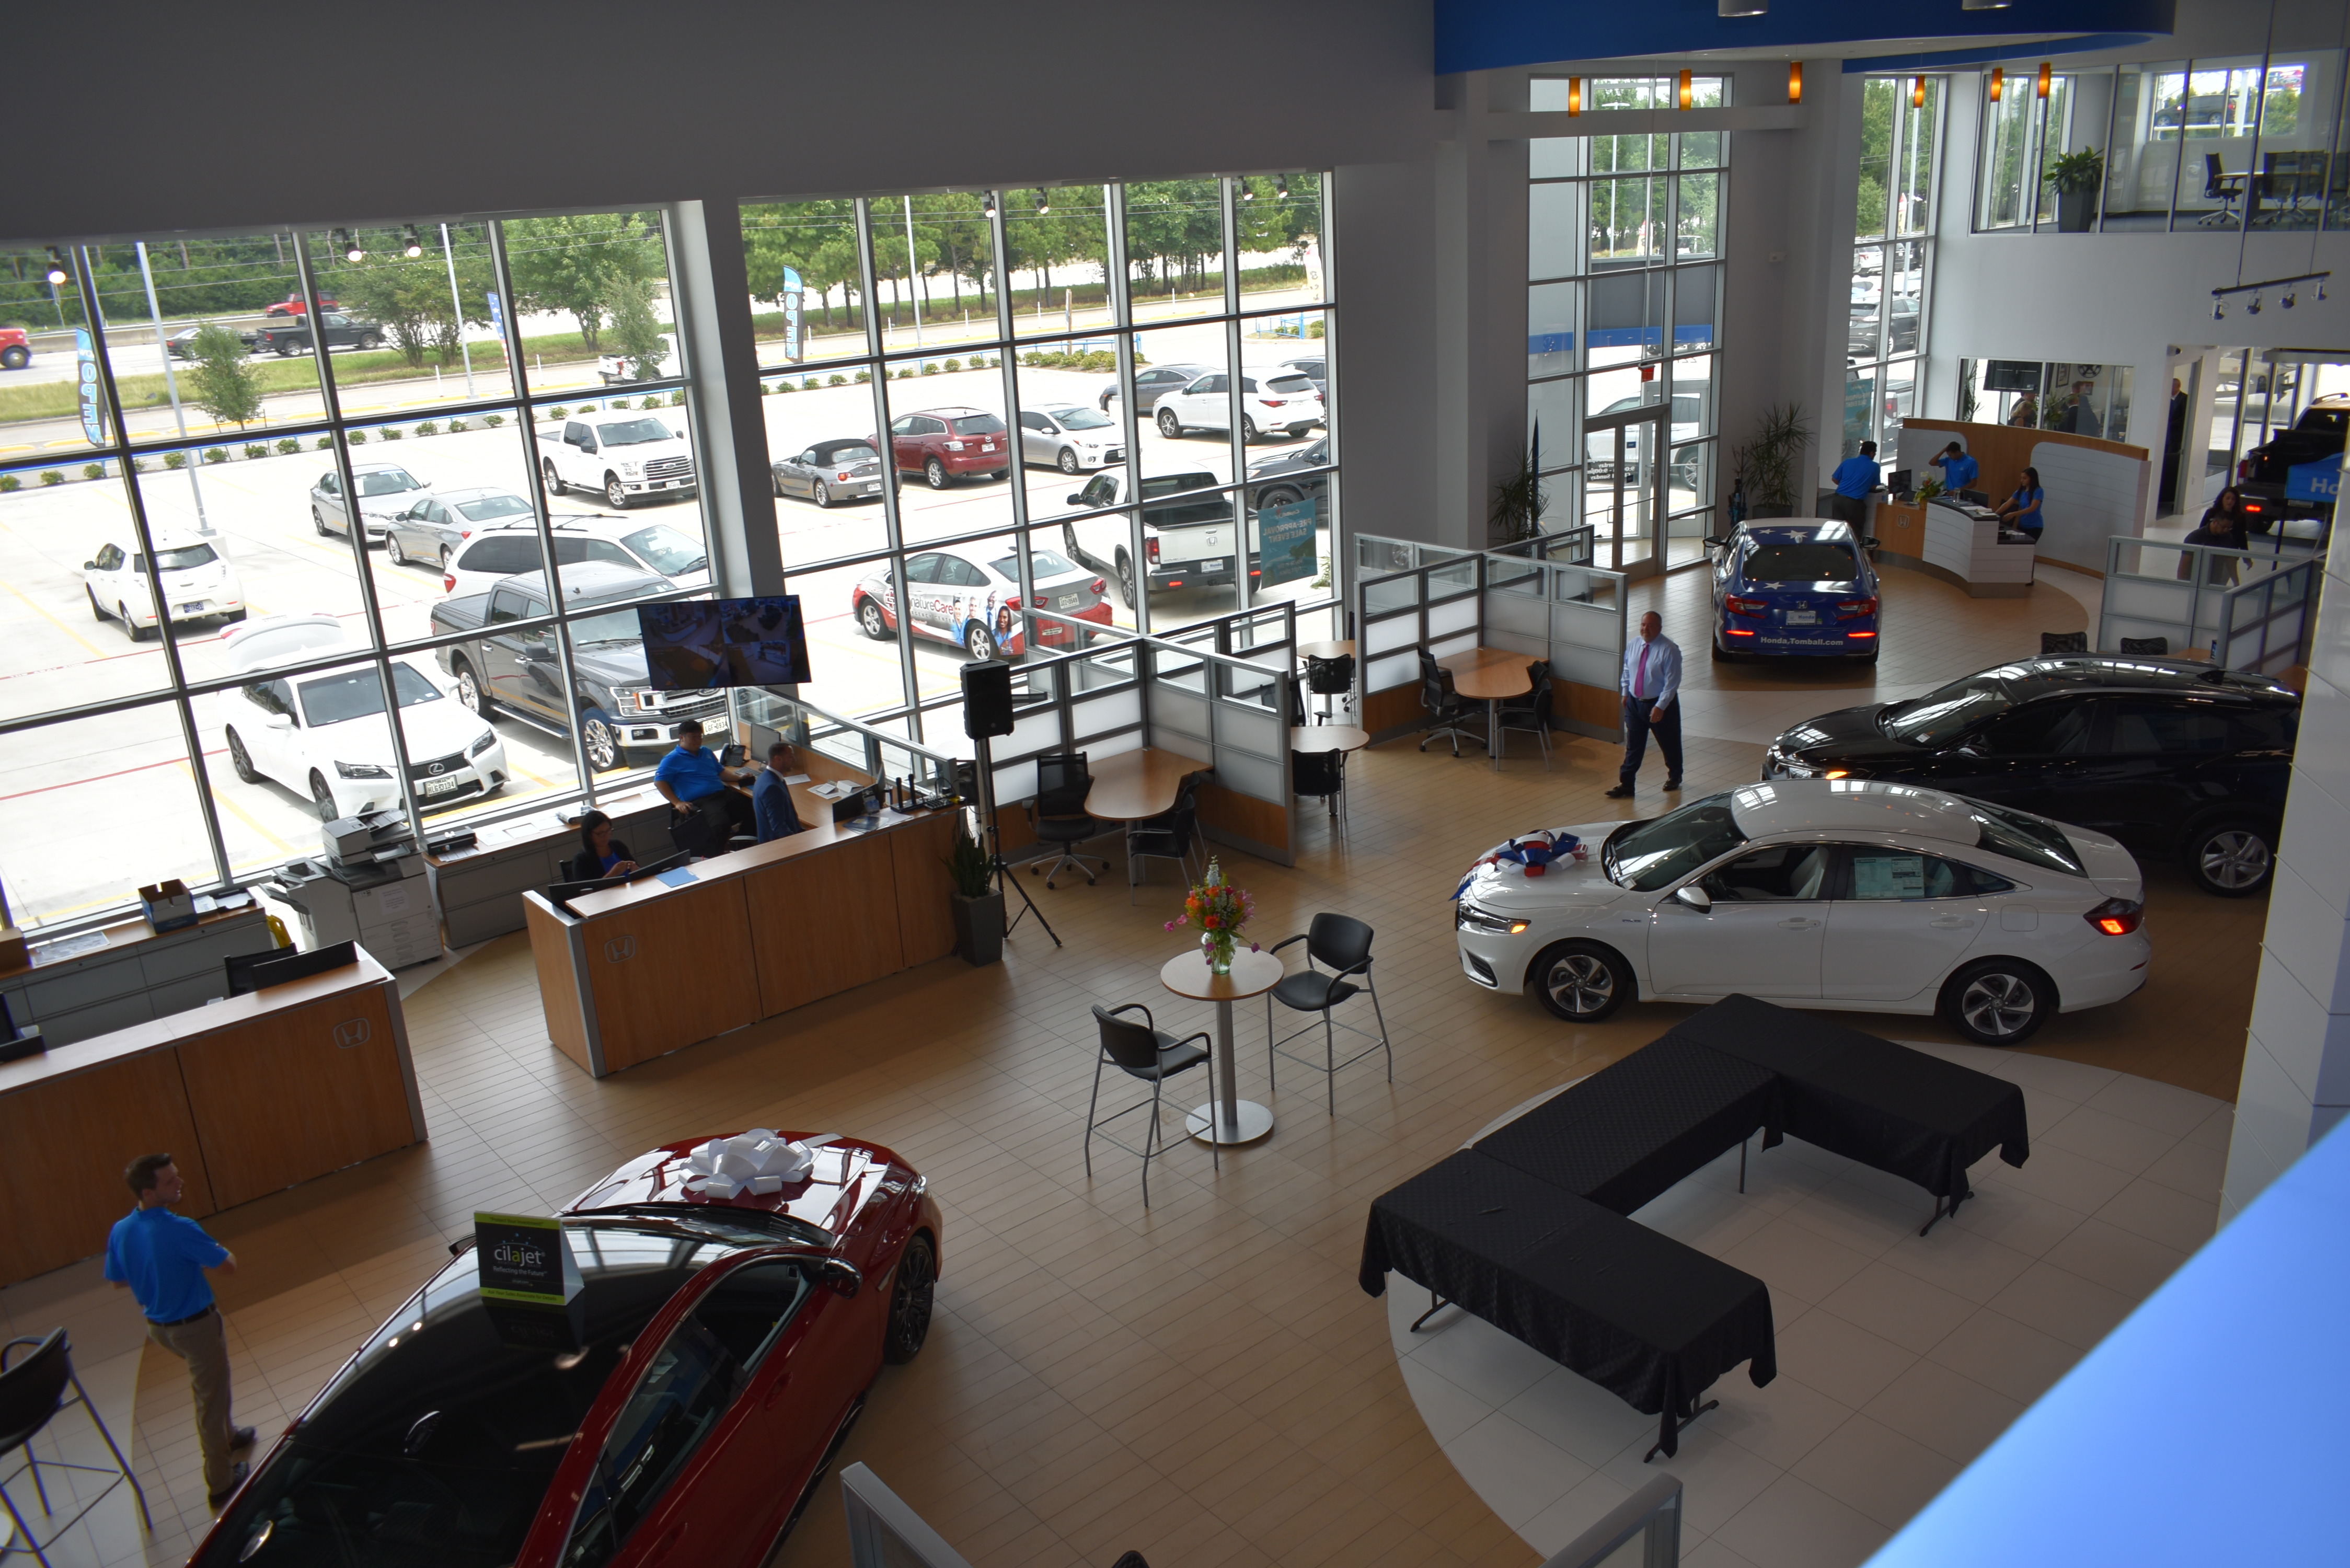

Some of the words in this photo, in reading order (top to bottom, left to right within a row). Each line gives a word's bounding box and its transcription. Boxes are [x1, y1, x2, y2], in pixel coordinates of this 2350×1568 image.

[2311, 477, 2339, 495] Ho
[910, 597, 953, 615] natureCare
[911, 610, 931, 619] RGENCY
[494, 1246, 542, 1266] cilajet
[493, 1266, 518, 1275] Reflecting
